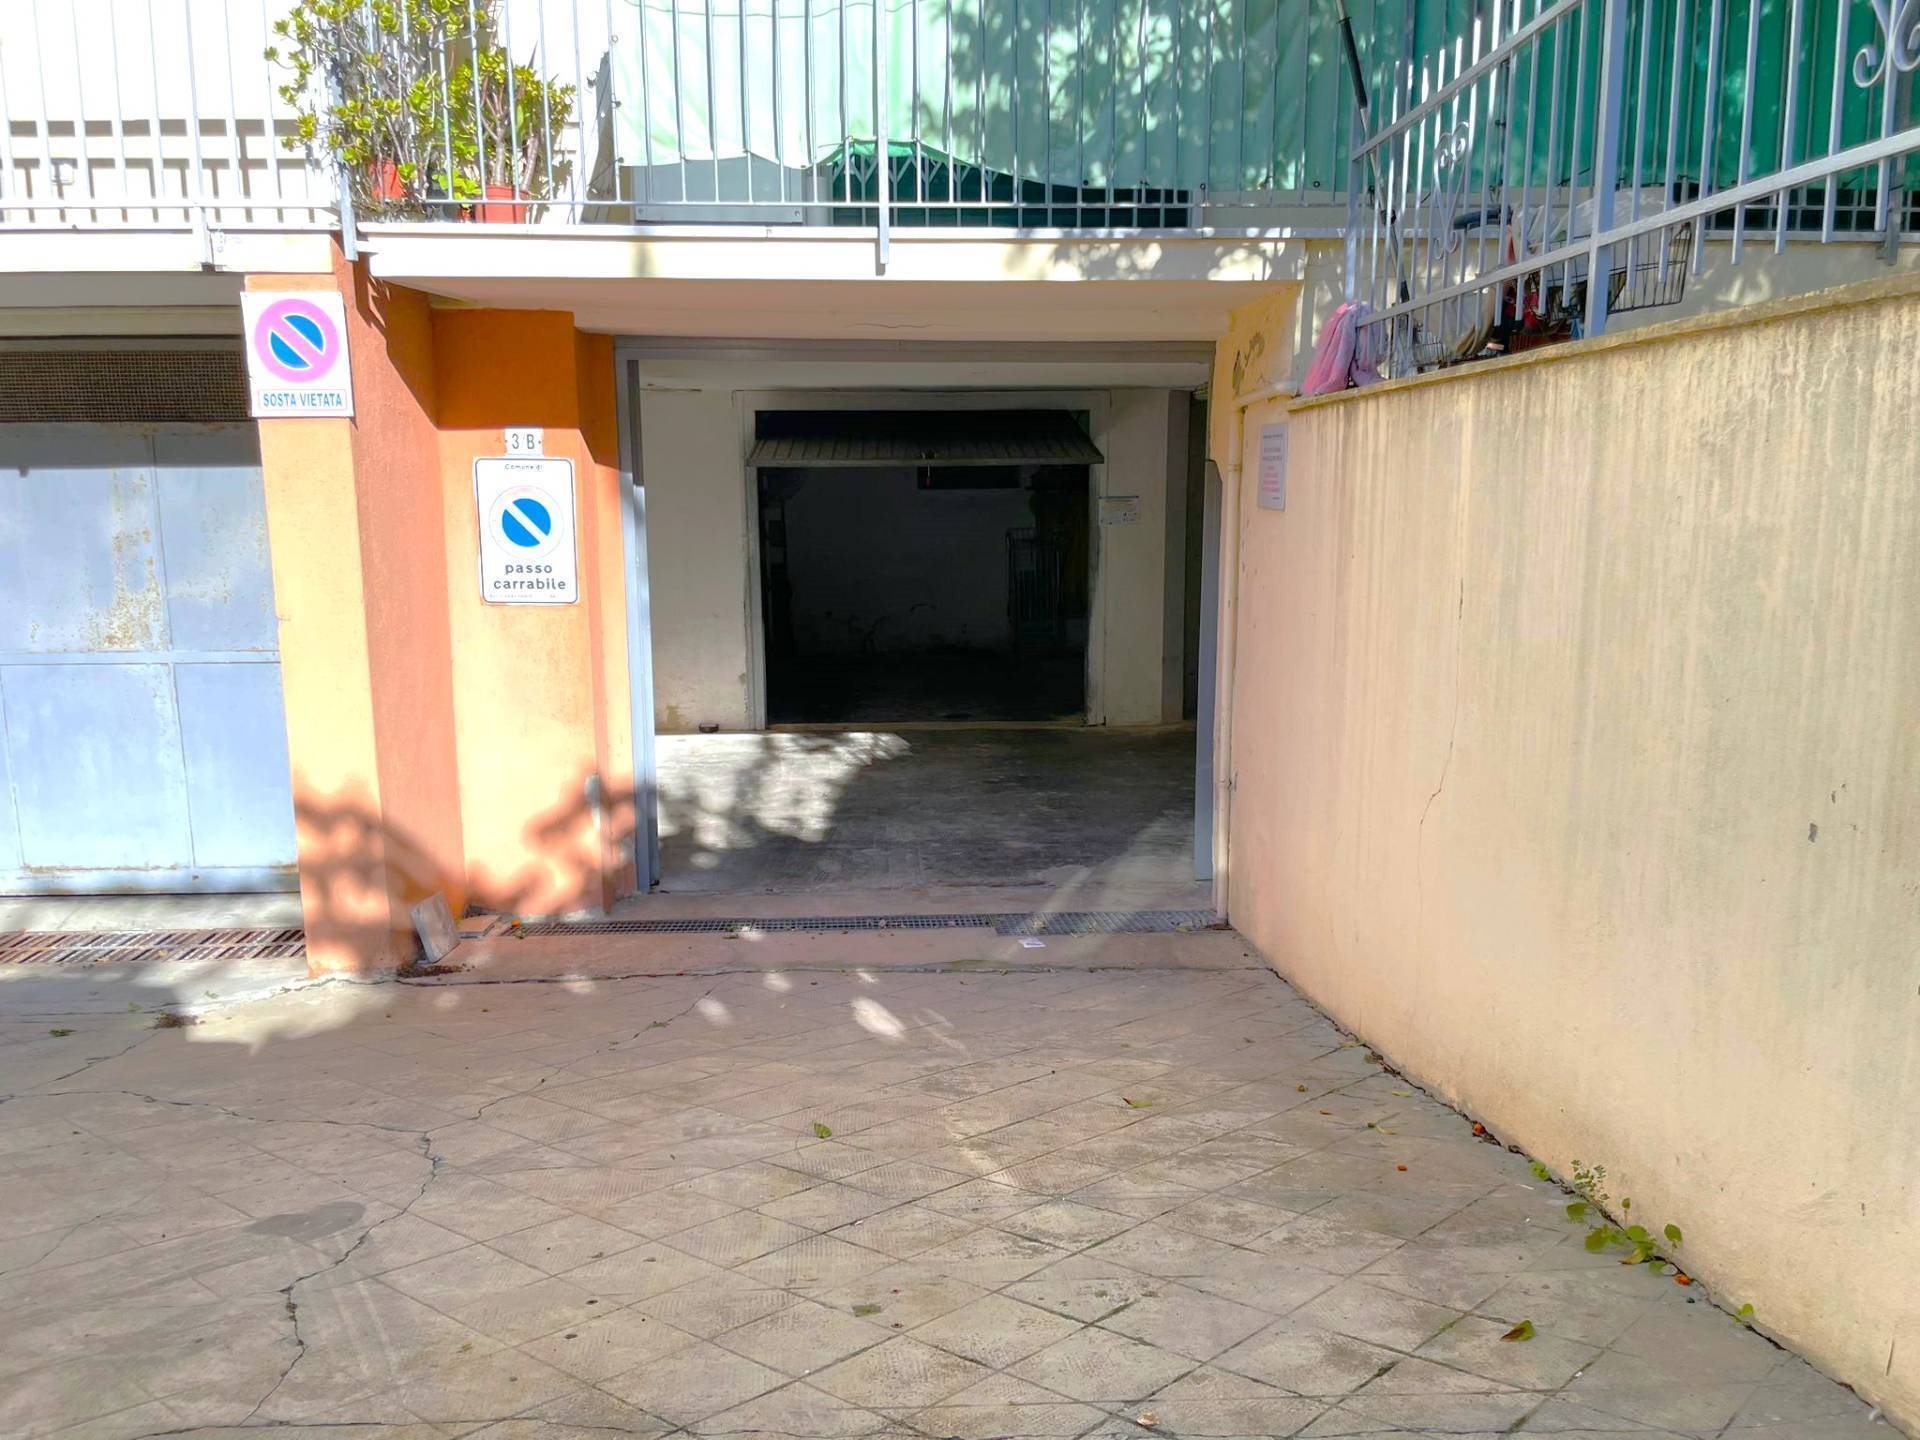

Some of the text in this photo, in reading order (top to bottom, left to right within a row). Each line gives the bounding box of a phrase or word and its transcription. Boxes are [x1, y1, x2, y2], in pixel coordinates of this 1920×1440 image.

[263, 393, 342, 407] SOSTA VIETATA
[505, 564, 552, 574] passo
[493, 578, 566, 590] carrabile
